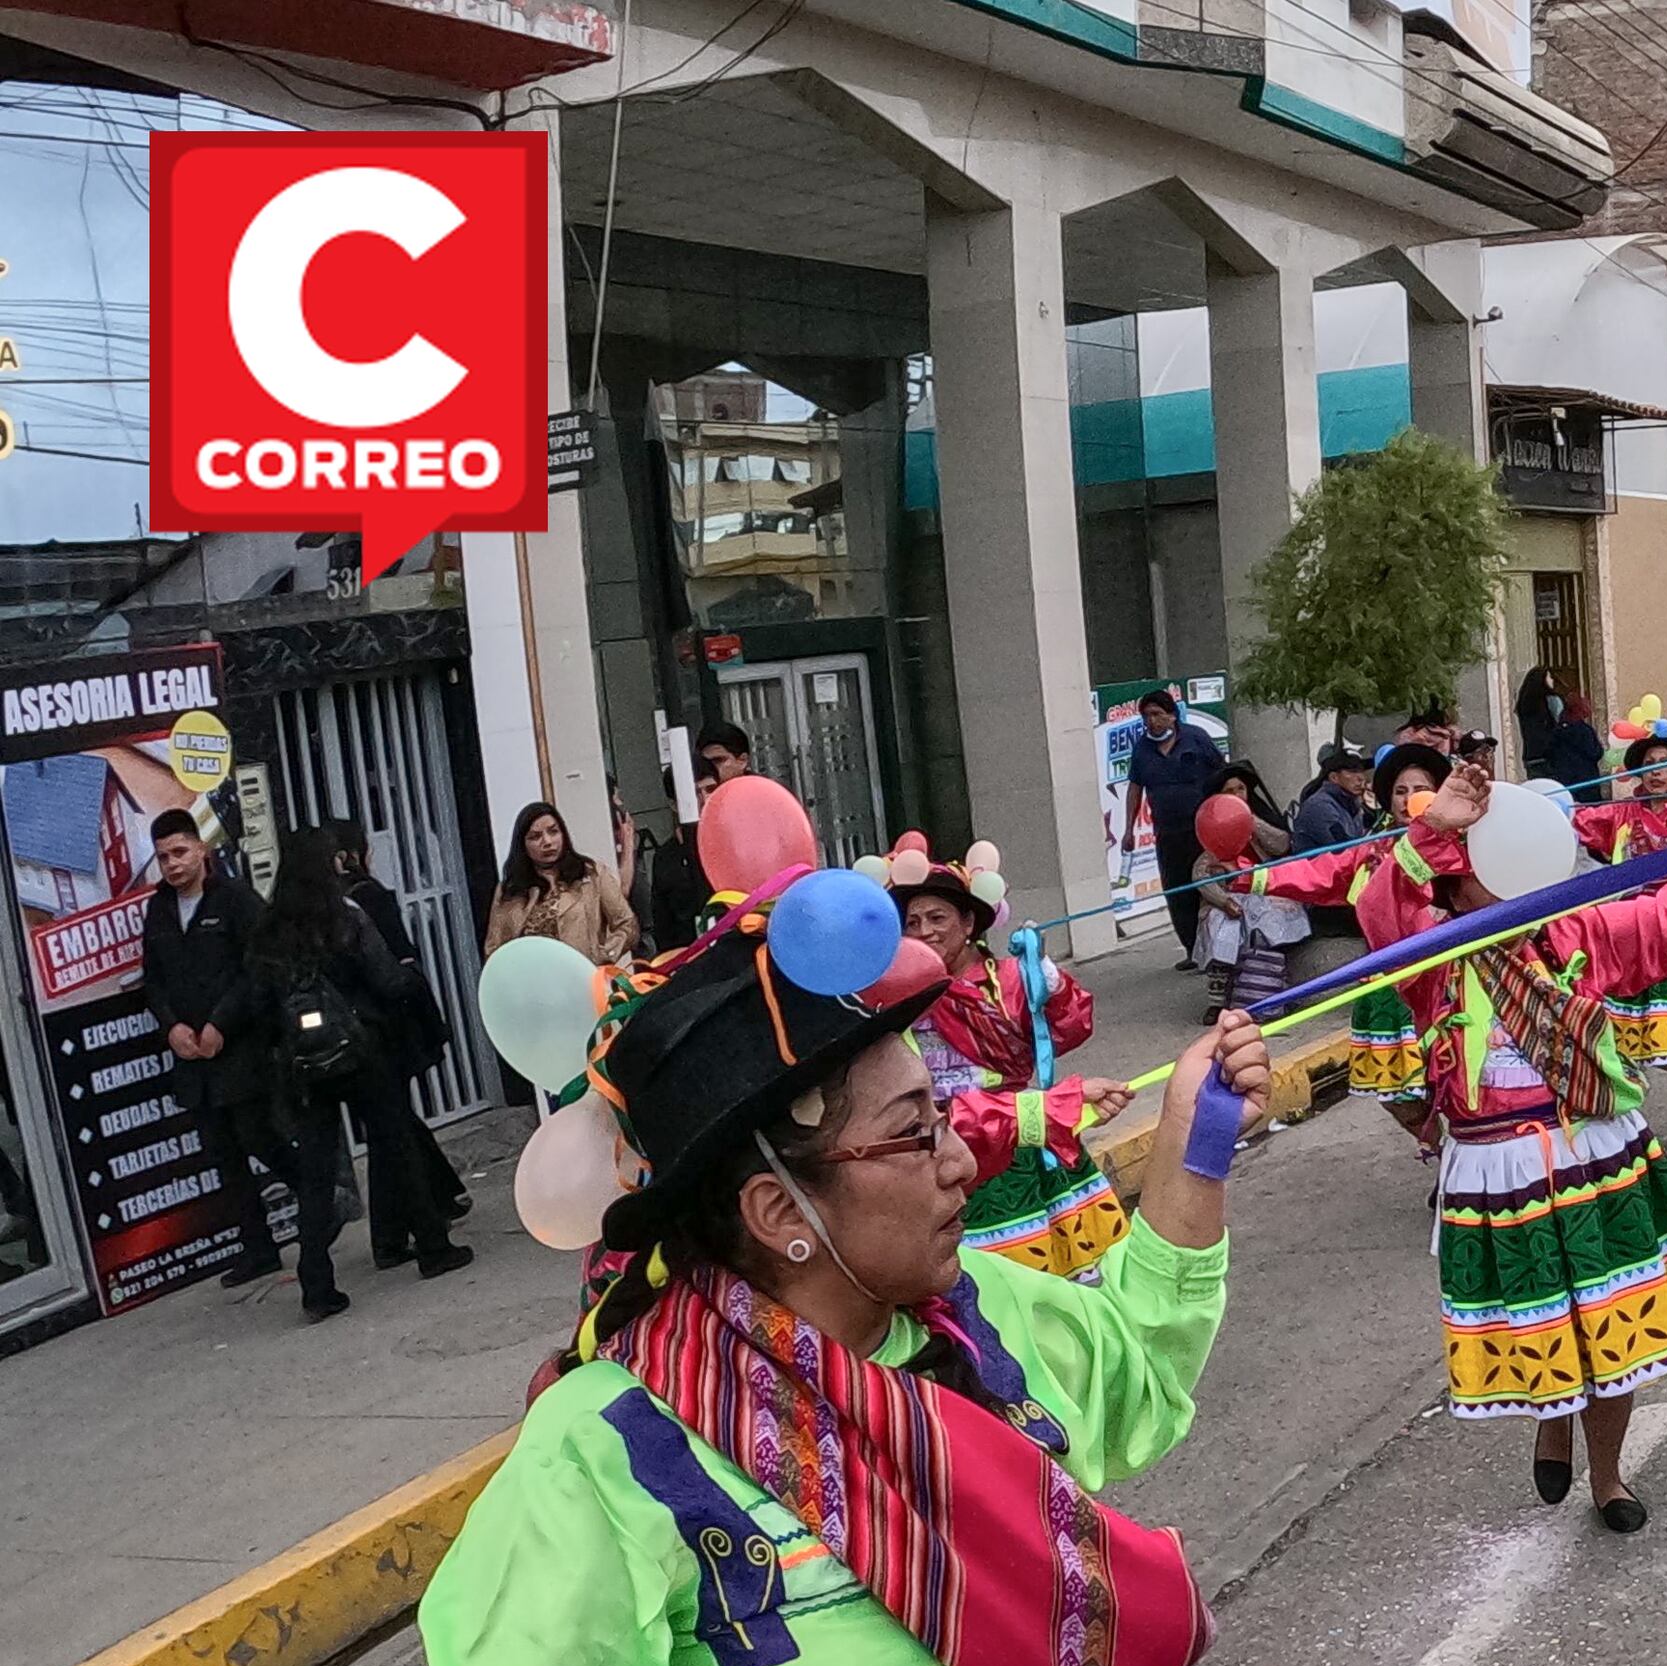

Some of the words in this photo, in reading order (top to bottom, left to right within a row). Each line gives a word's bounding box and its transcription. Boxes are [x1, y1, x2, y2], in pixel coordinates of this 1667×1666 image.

[548, 415, 581, 433] ECIBE
[574, 430, 590, 445] DE
[548, 446, 595, 467] OSTURAS
[4, 674, 136, 735] ASESORIA
[138, 665, 218, 715] LEGAL
[82, 1007, 160, 1051] EJECUCIÓ
[91, 1054, 161, 1095] REMATES
[161, 1048, 174, 1073] D
[99, 1098, 162, 1138] DEUDAS
[107, 1136, 180, 1180] TARJETAS
[180, 1129, 203, 1156] DE
[117, 1175, 200, 1223] TERCERÍAS
[199, 1167, 222, 1194] DE
[119, 1258, 157, 1281] PASEO
[157, 1252, 174, 1266] LA
